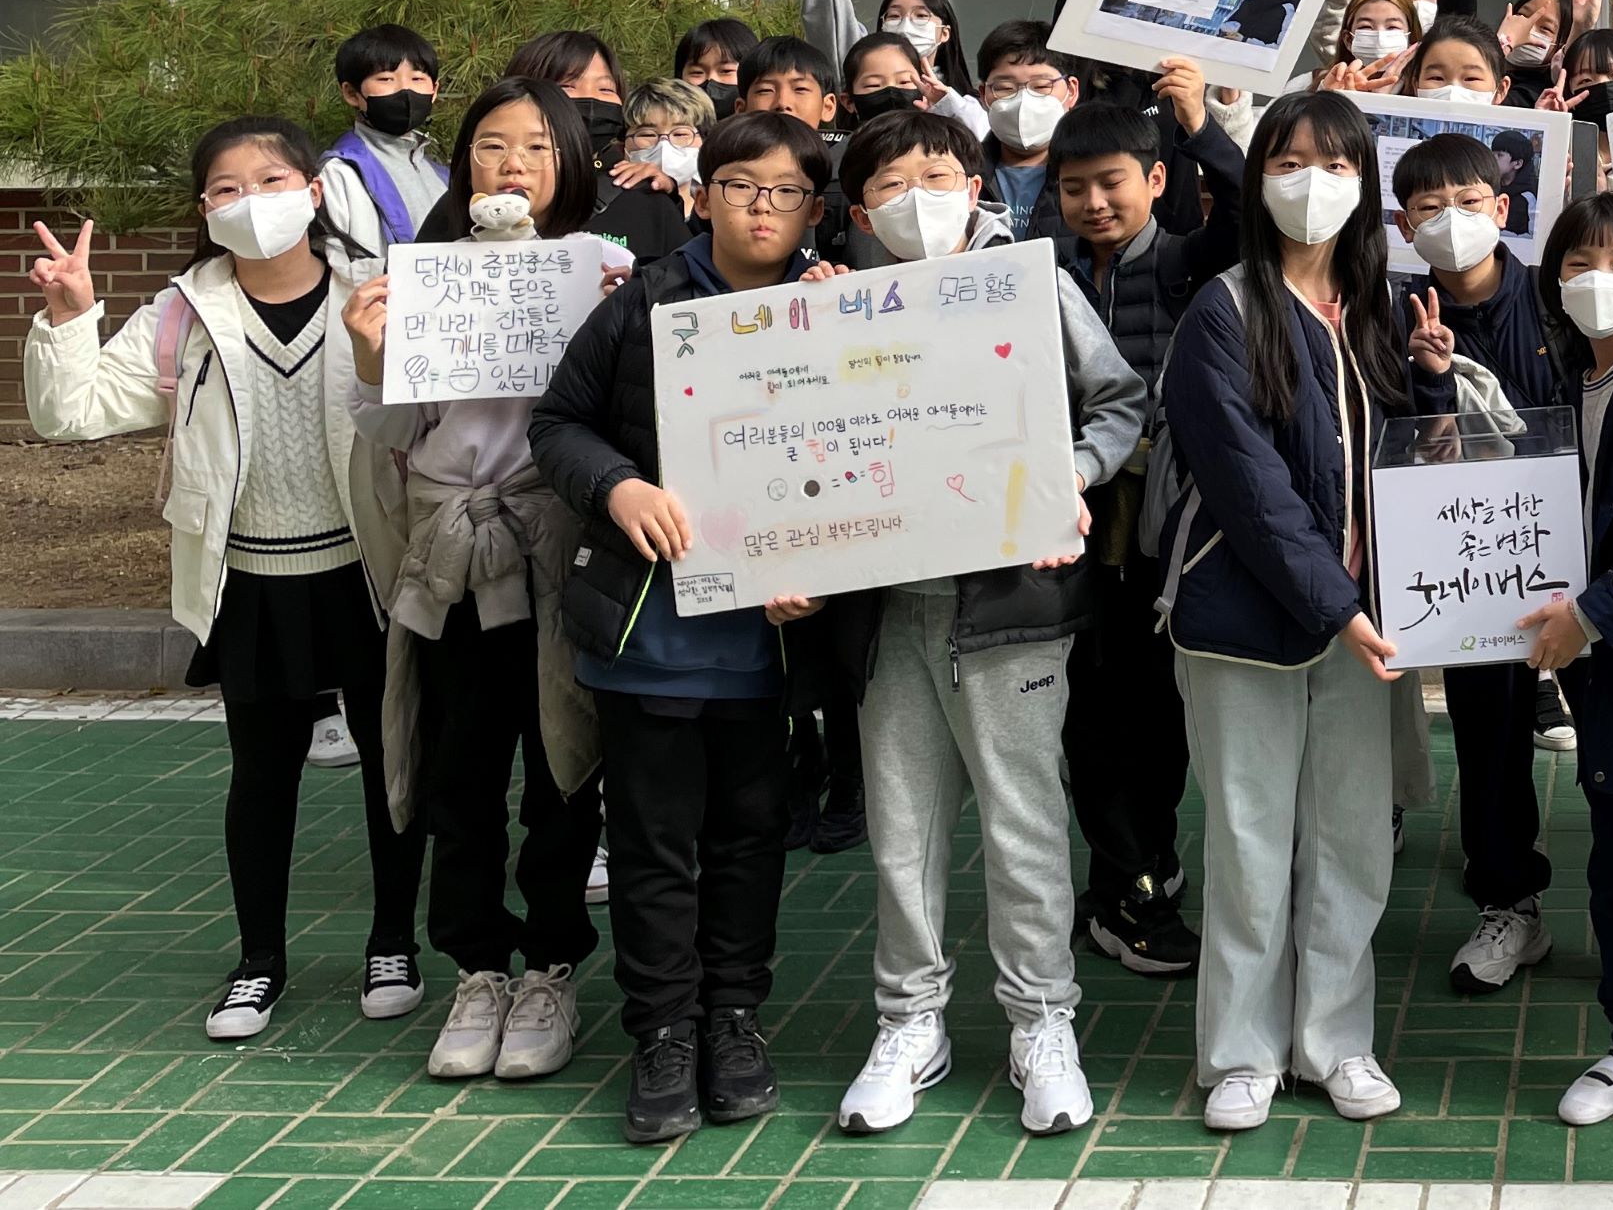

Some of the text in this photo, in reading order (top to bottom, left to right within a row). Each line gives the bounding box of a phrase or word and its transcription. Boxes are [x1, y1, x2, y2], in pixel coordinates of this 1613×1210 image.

[415, 254, 472, 287] 당신이
[435, 278, 560, 307] 사 먹는 돈으로
[938, 276, 977, 306] 모금
[984, 273, 1017, 302] 활동
[405, 315, 426, 340] 먼
[439, 313, 475, 333] 나라
[441, 332, 501, 361] 끼니를
[723, 402, 988, 450] 여러분들의 100원 이라도 어려운 아이들에게는
[786, 448, 800, 462] 큰
[806, 438, 839, 463] 힘이
[868, 460, 896, 498] 힘
[1437, 492, 1543, 524] 세상을 위한
[744, 532, 780, 557] 많은
[786, 524, 822, 548] 관심
[1458, 522, 1551, 561] 좋은 변화
[1400, 563, 1569, 630] 굿네이버스
[1478, 634, 1526, 649] 굿네이버스
[1020, 674, 1055, 693] Jeep
